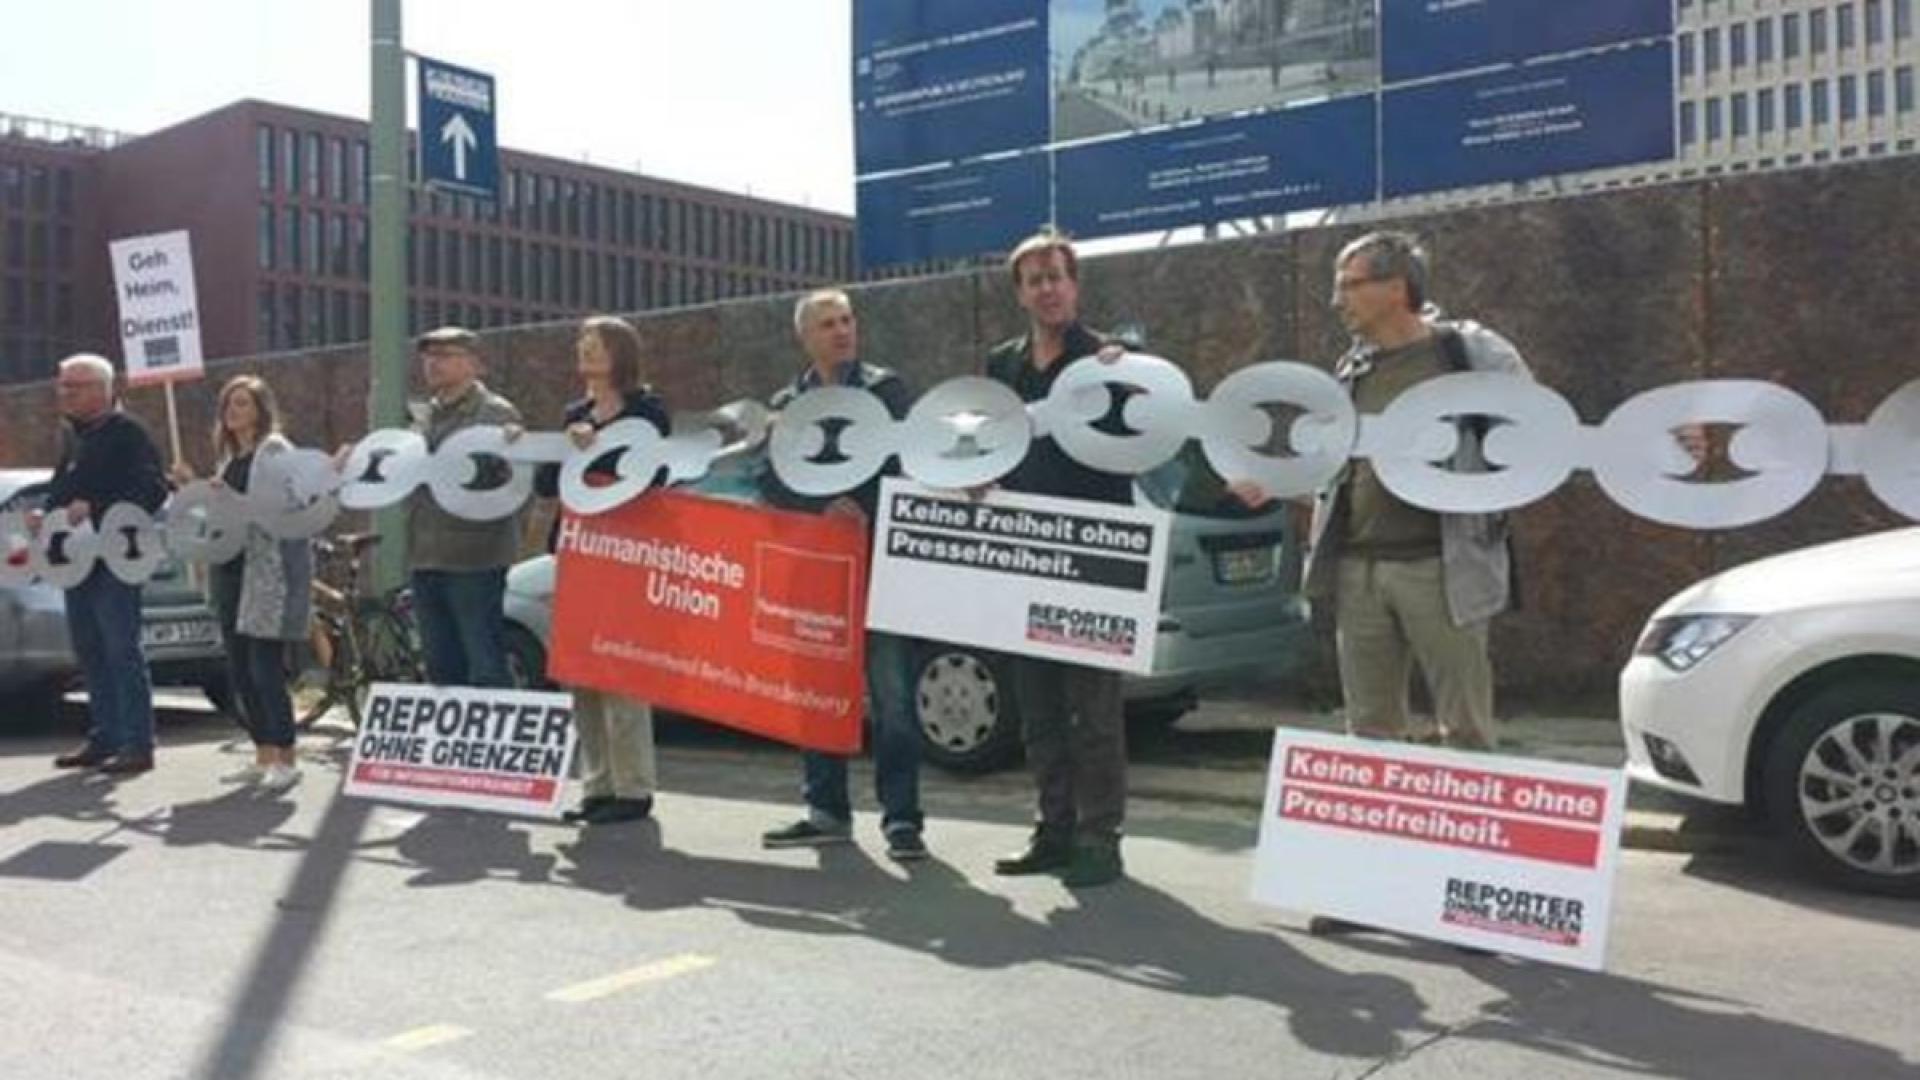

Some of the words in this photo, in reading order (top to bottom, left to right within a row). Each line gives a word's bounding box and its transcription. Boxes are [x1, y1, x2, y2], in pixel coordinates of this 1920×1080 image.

[128, 249, 168, 272] Geh
[124, 310, 193, 337] Dienst!
[894, 498, 969, 526] Keine
[975, 507, 1074, 541] Freiheit
[1080, 523, 1147, 550] ohne
[559, 518, 745, 588] Humanistische
[891, 531, 1080, 577] Pressefreiheit.
[647, 571, 720, 621] Union
[1028, 603, 1137, 635] REPORTER
[367, 696, 572, 745] REPORTER
[360, 735, 427, 763] OHNE
[431, 740, 564, 776] GRENZEN
[1289, 750, 1374, 785] Keine
[1383, 763, 1504, 801] Freiheit
[1513, 784, 1597, 818] ohne
[1284, 789, 1511, 848] Pressefreiheit.
[1446, 878, 1584, 920] REPORTER
